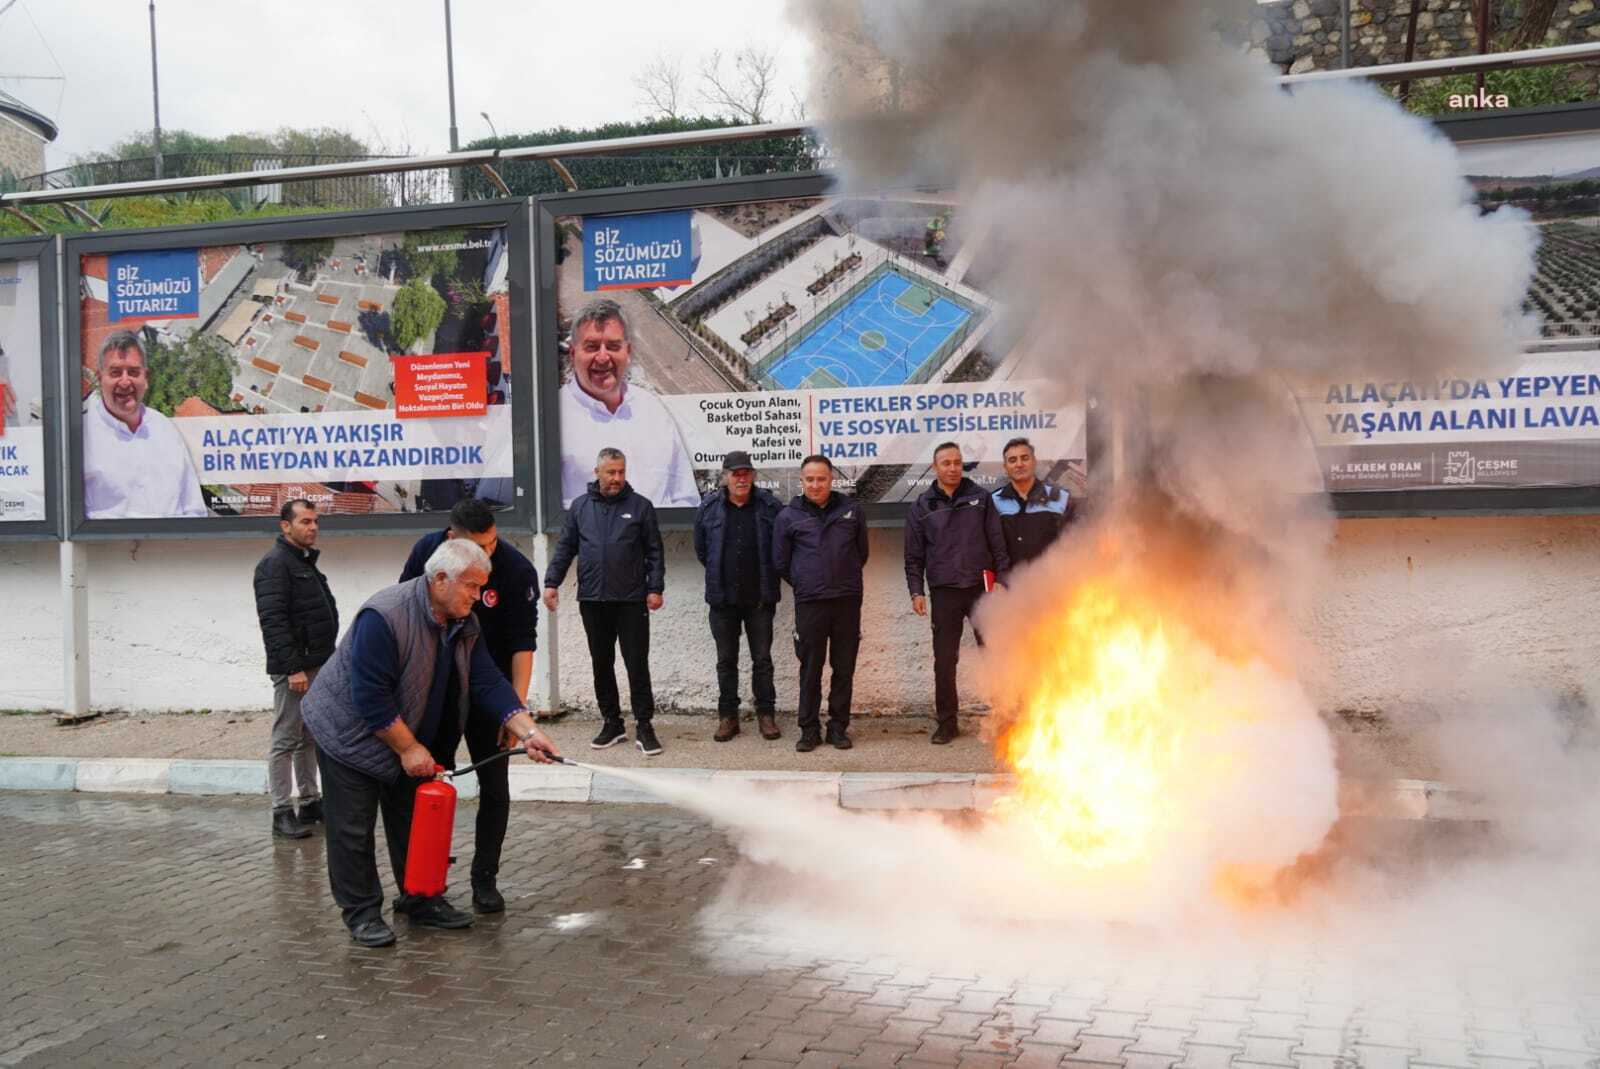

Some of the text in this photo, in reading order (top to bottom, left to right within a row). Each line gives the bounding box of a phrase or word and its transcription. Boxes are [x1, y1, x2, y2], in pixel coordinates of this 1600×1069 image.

[595, 227, 619, 245] BİZ
[595, 240, 682, 263] SÖZÜMÜZÜ
[117, 265, 139, 281] BİZ
[595, 263, 666, 281] TUTARIZ!
[116, 278, 191, 297] SÖZÜMÜZÜ
[117, 299, 178, 313] TUTARIZ!
[414, 383, 438, 391] Sosyal
[452, 402, 464, 410] Biri
[466, 401, 484, 409] Oldu
[700, 397, 800, 412] Çocuk Oyun Alanı,
[819, 391, 1025, 414] PETEKLER SPOR PARK
[707, 410, 801, 423] Basketbol Sahası
[819, 410, 1057, 436] VE SOSYAL TESİSLERİMİZ
[1326, 410, 1422, 438] YAŞAM
[1429, 408, 1516, 432] ALANI
[203, 424, 403, 451] ALAÇATI'YA YAKIŞIR
[726, 423, 801, 437] Kaya Bahçesi,
[752, 437, 802, 448] Kafesi ve
[820, 442, 877, 458] HAZIR
[204, 445, 483, 471] BİR MEYDAN KAZANDIRDIK
[789, 449, 802, 460] ile
[1330, 462, 1422, 472] M. EKREM ORAN
[1476, 459, 1518, 470] ÇEŞME
[832, 479, 857, 488] EŞME
